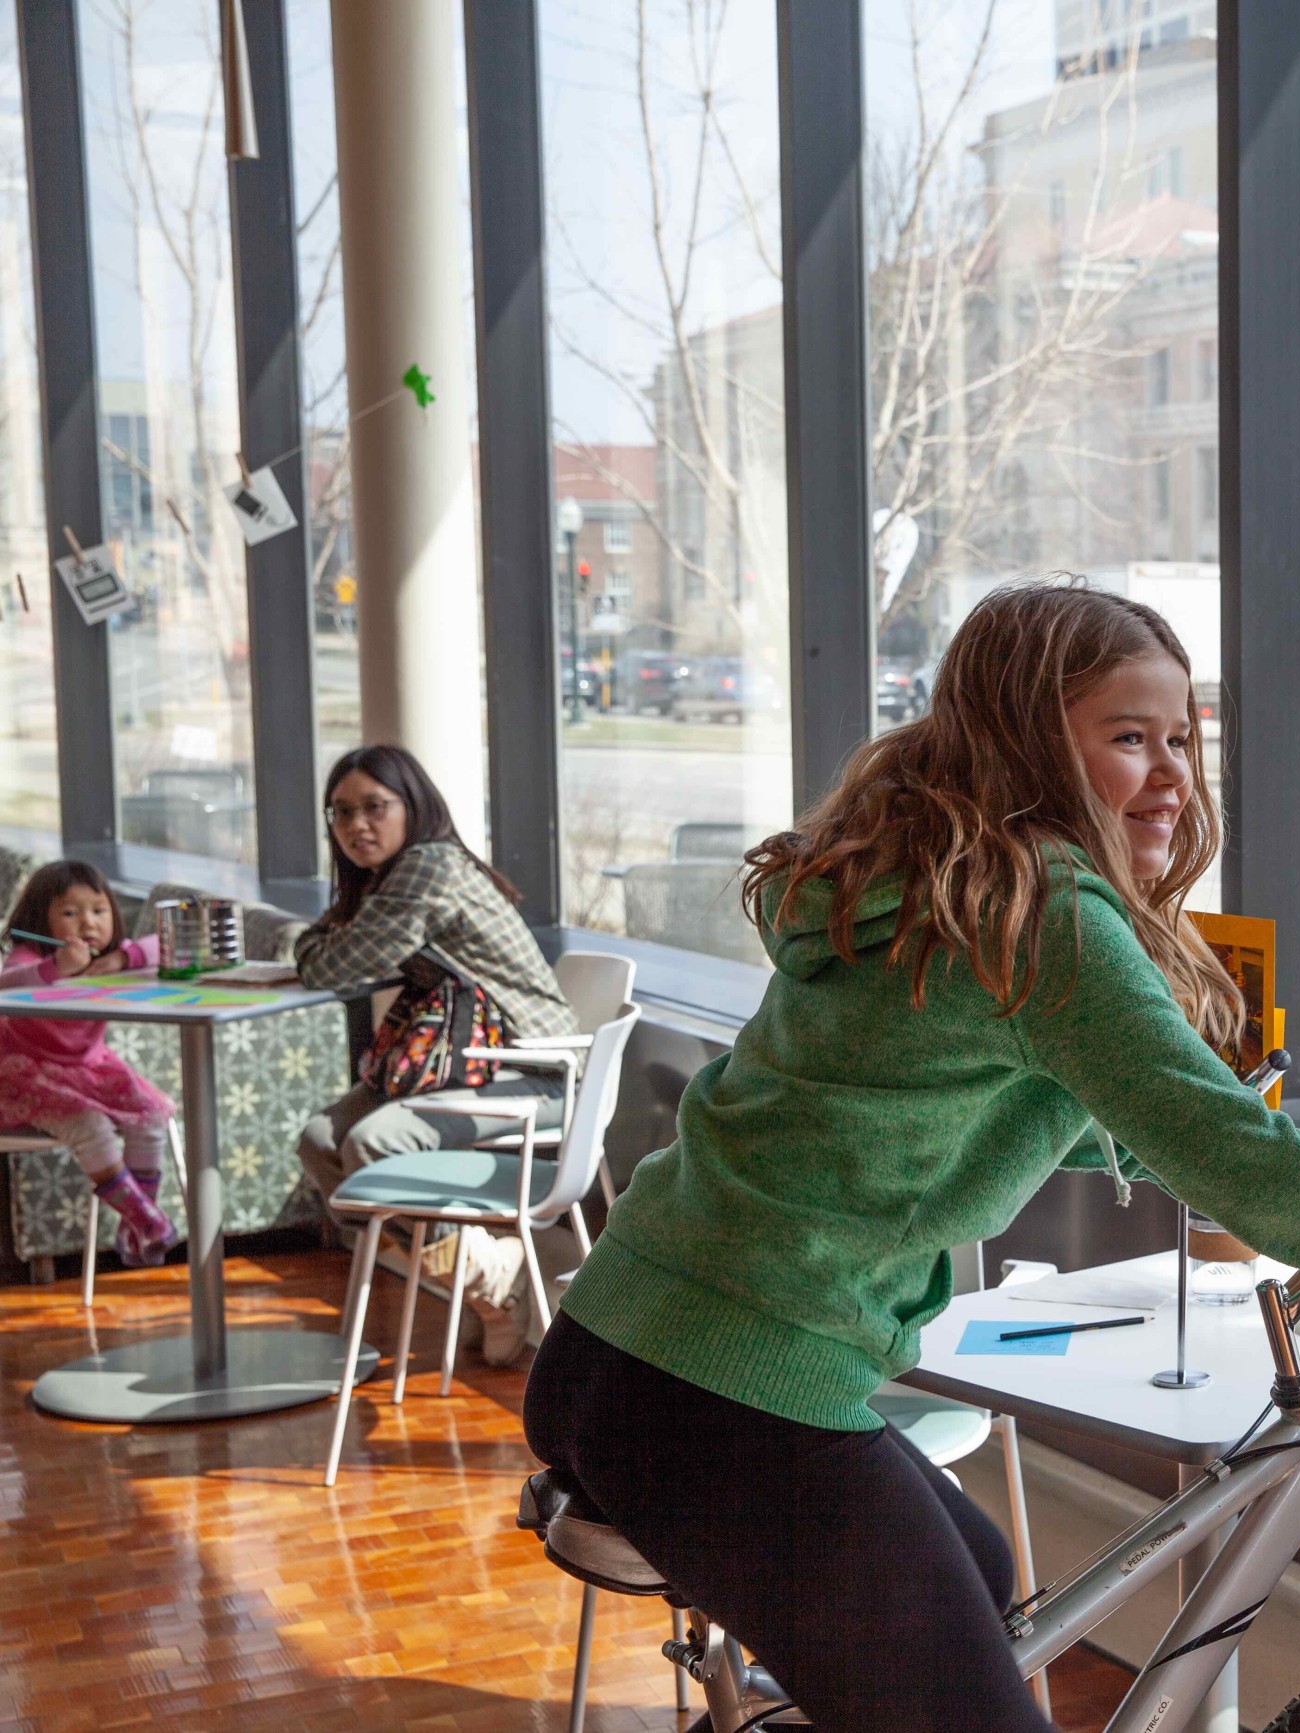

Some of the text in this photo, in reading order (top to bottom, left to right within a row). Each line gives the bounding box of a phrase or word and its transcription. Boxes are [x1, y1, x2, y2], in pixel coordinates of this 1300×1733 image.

[1127, 1548, 1151, 1567] PEDAL
[1143, 1701, 1170, 1733] TRIC CO.
